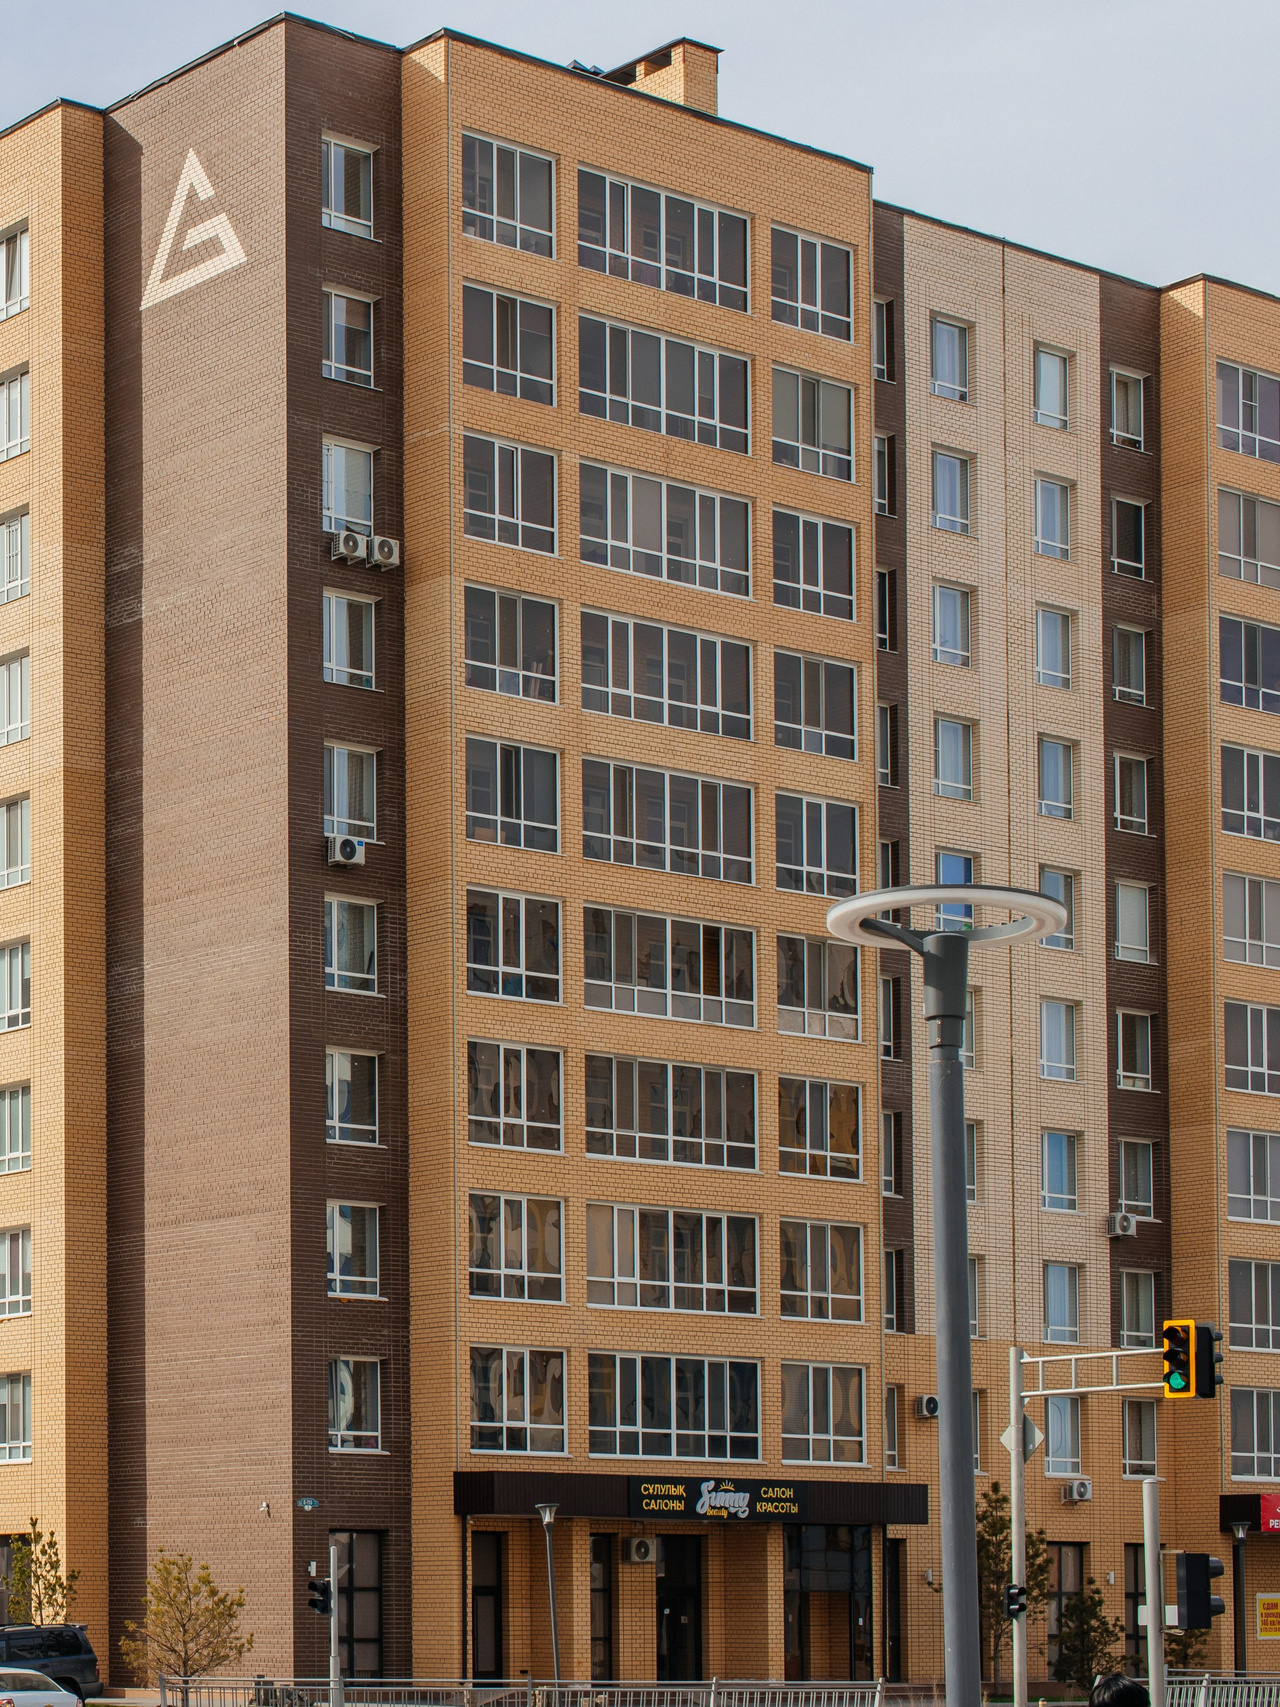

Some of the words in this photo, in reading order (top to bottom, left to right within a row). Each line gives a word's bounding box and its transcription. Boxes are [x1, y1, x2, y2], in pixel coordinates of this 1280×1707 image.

[641, 1483, 687, 1498] СҰЛУЛЫҚ
[760, 1487, 794, 1499] САЛОН
[642, 1499, 685, 1511] САЛОНЫ
[696, 1480, 750, 1518] Sunny
[706, 1506, 729, 1519] Beauty
[756, 1502, 799, 1514] КРАСОТЫ
[1269, 1518, 1280, 1529] РЕ
